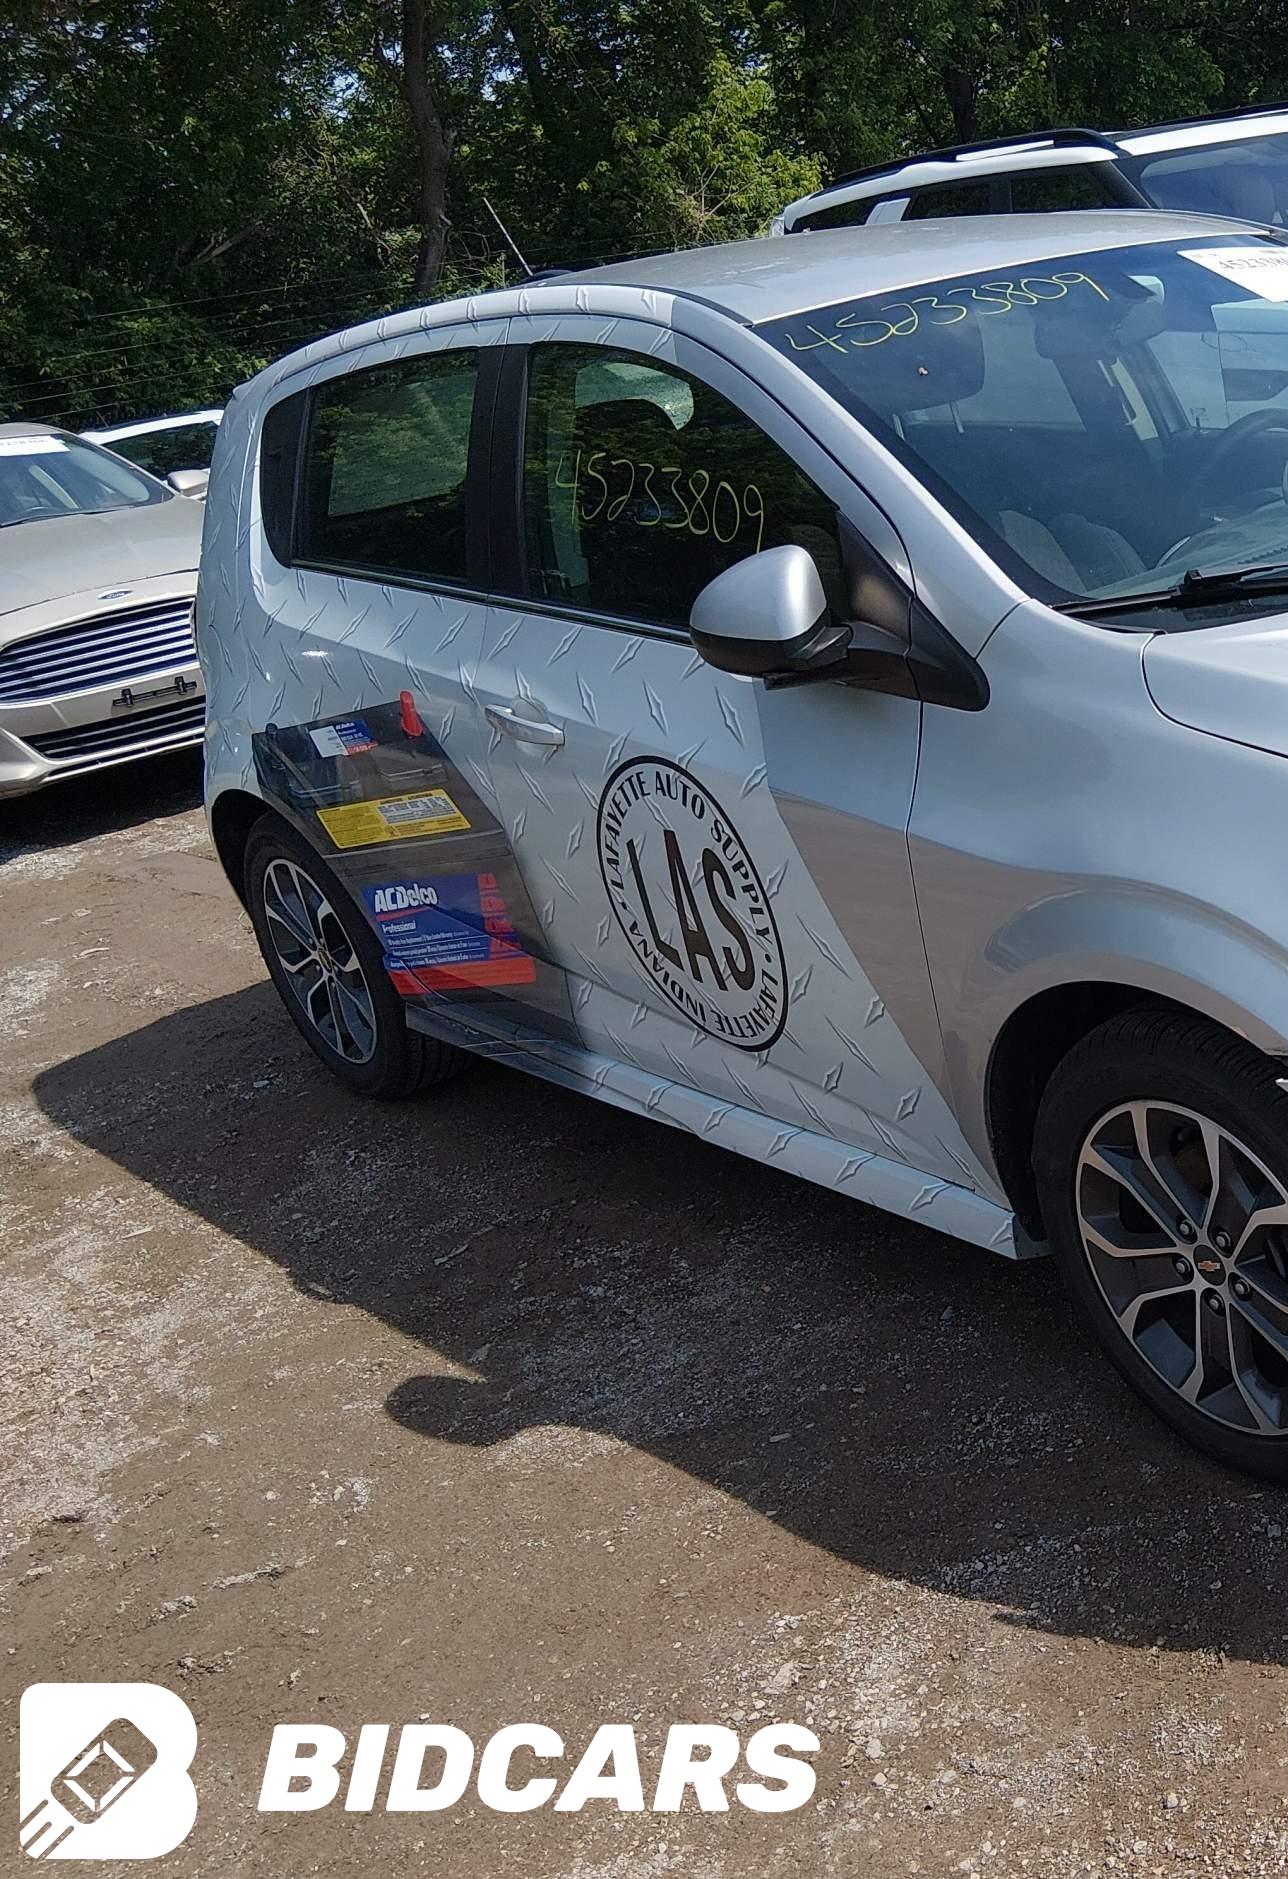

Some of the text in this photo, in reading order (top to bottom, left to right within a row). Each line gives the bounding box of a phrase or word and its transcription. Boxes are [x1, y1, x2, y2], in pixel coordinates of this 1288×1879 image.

[785, 272, 1110, 353] 45233809
[555, 449, 764, 553] 45233809
[374, 883, 438, 913] ACDelco
[604, 770, 771, 939] LAFAYETTE AUTO SUPPLY
[626, 829, 756, 992] LAS
[629, 920, 779, 1039] LAFAYETTE INDIANA
